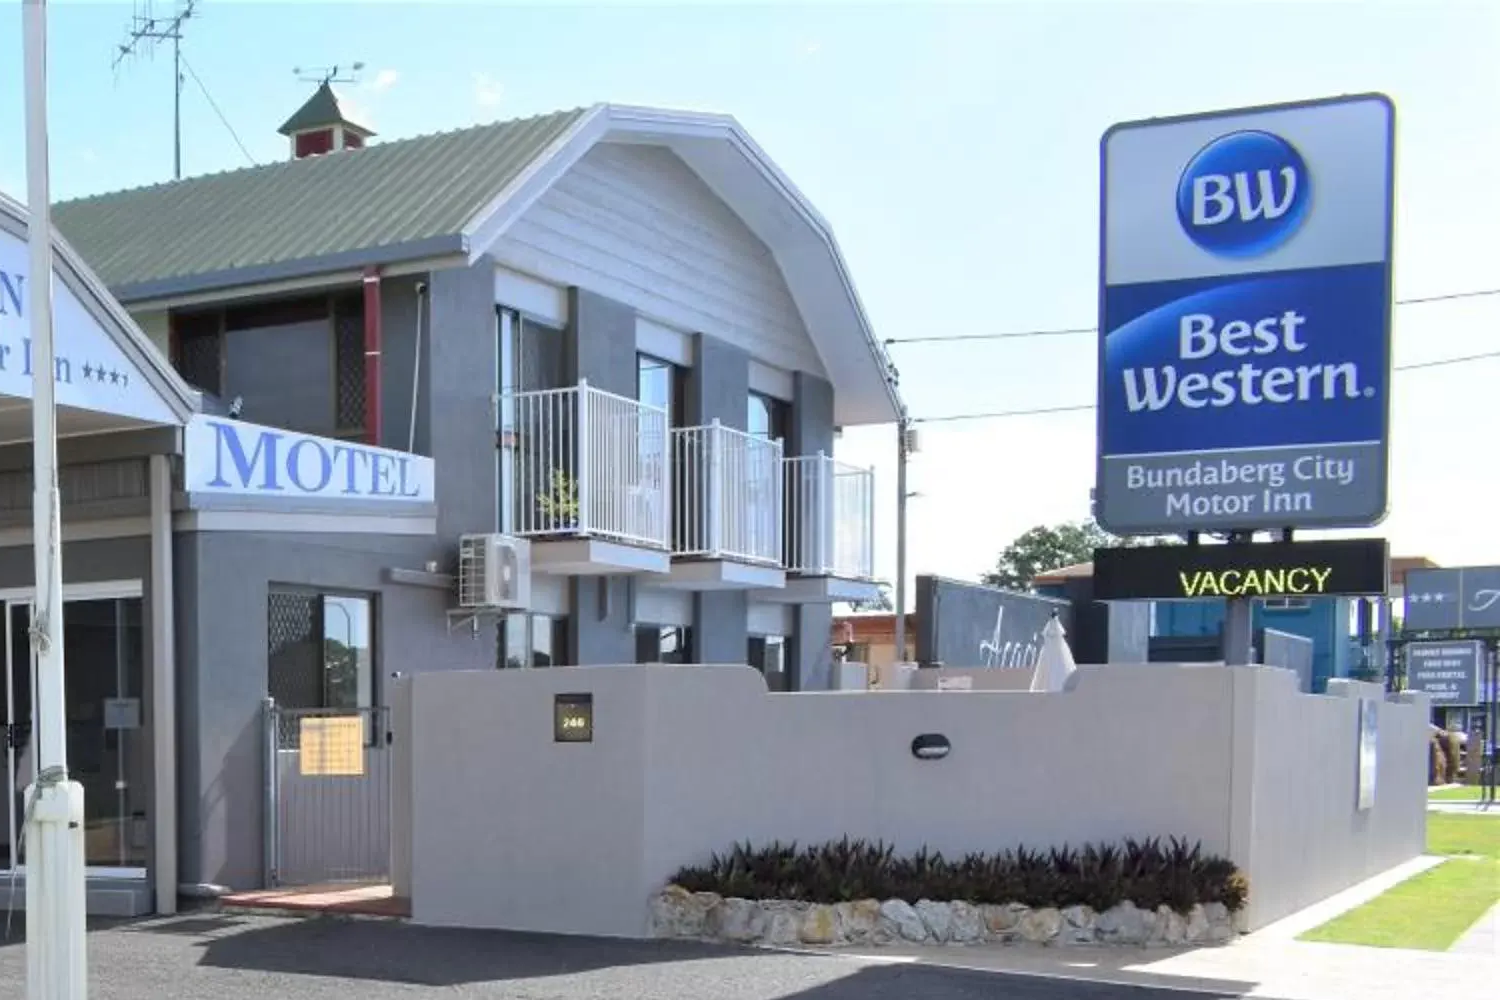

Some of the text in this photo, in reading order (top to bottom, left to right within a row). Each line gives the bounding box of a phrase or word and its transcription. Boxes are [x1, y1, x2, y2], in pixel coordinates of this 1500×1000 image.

[1192, 166, 1295, 226] BW
[1178, 310, 1308, 360] Best
[21, 337, 73, 384] In
[206, 420, 421, 497] MOTEL
[1126, 455, 1356, 488] Bundaberg City
[1165, 489, 1313, 517] Motor Inn
[1179, 567, 1333, 597] VACANCY
